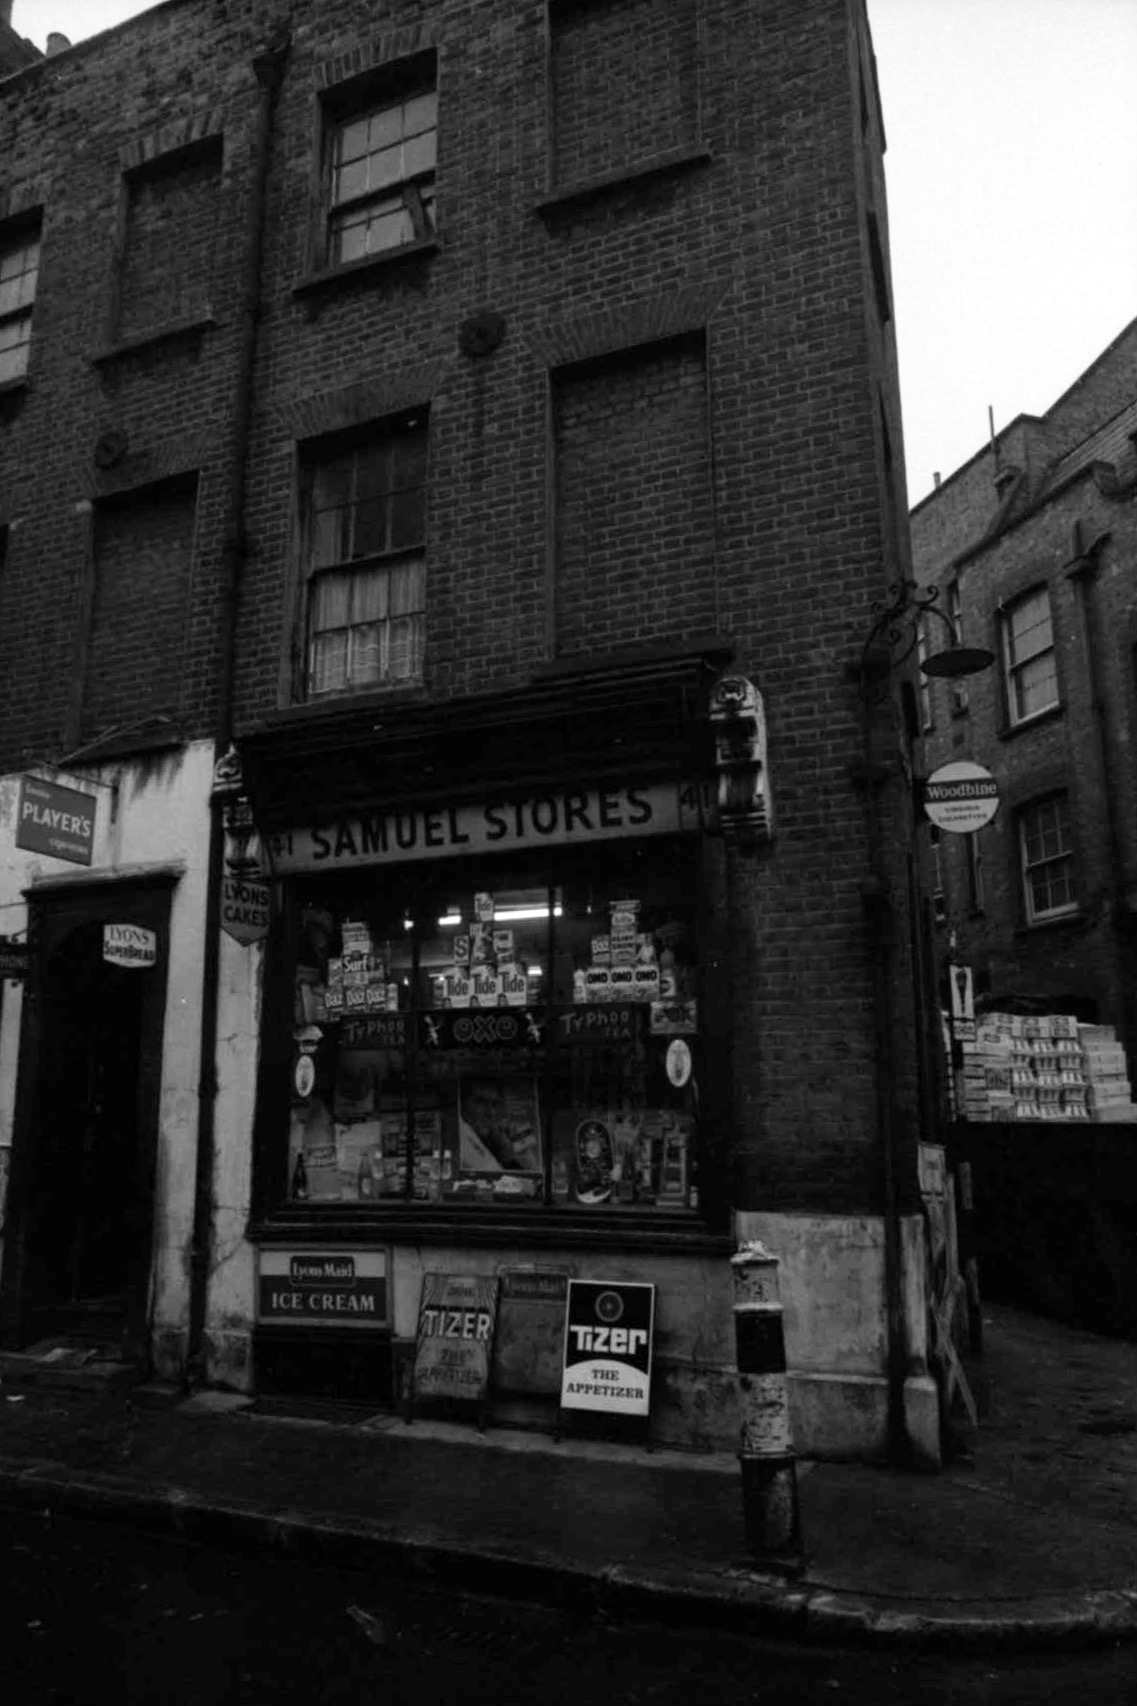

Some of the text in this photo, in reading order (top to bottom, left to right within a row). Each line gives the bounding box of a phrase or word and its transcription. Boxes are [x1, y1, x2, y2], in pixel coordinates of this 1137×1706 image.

[926, 782, 997, 800] Woodbine
[22, 800, 92, 838] PLAYER'S
[311, 786, 653, 859] SAMUEL STORES
[224, 881, 268, 906] LYONS
[223, 904, 268, 927] CAKES
[109, 925, 150, 945] LYONS
[445, 975, 469, 996] Tide
[472, 973, 496, 994] Tide
[499, 971, 525, 994] Tide
[453, 1016, 519, 1044] OXO
[271, 1291, 375, 1312] ICE CREAM
[424, 1308, 491, 1341] TIZER
[569, 1324, 648, 1355] Tizer
[591, 1368, 620, 1381] THE
[565, 1382, 645, 1400] APPETIZER
